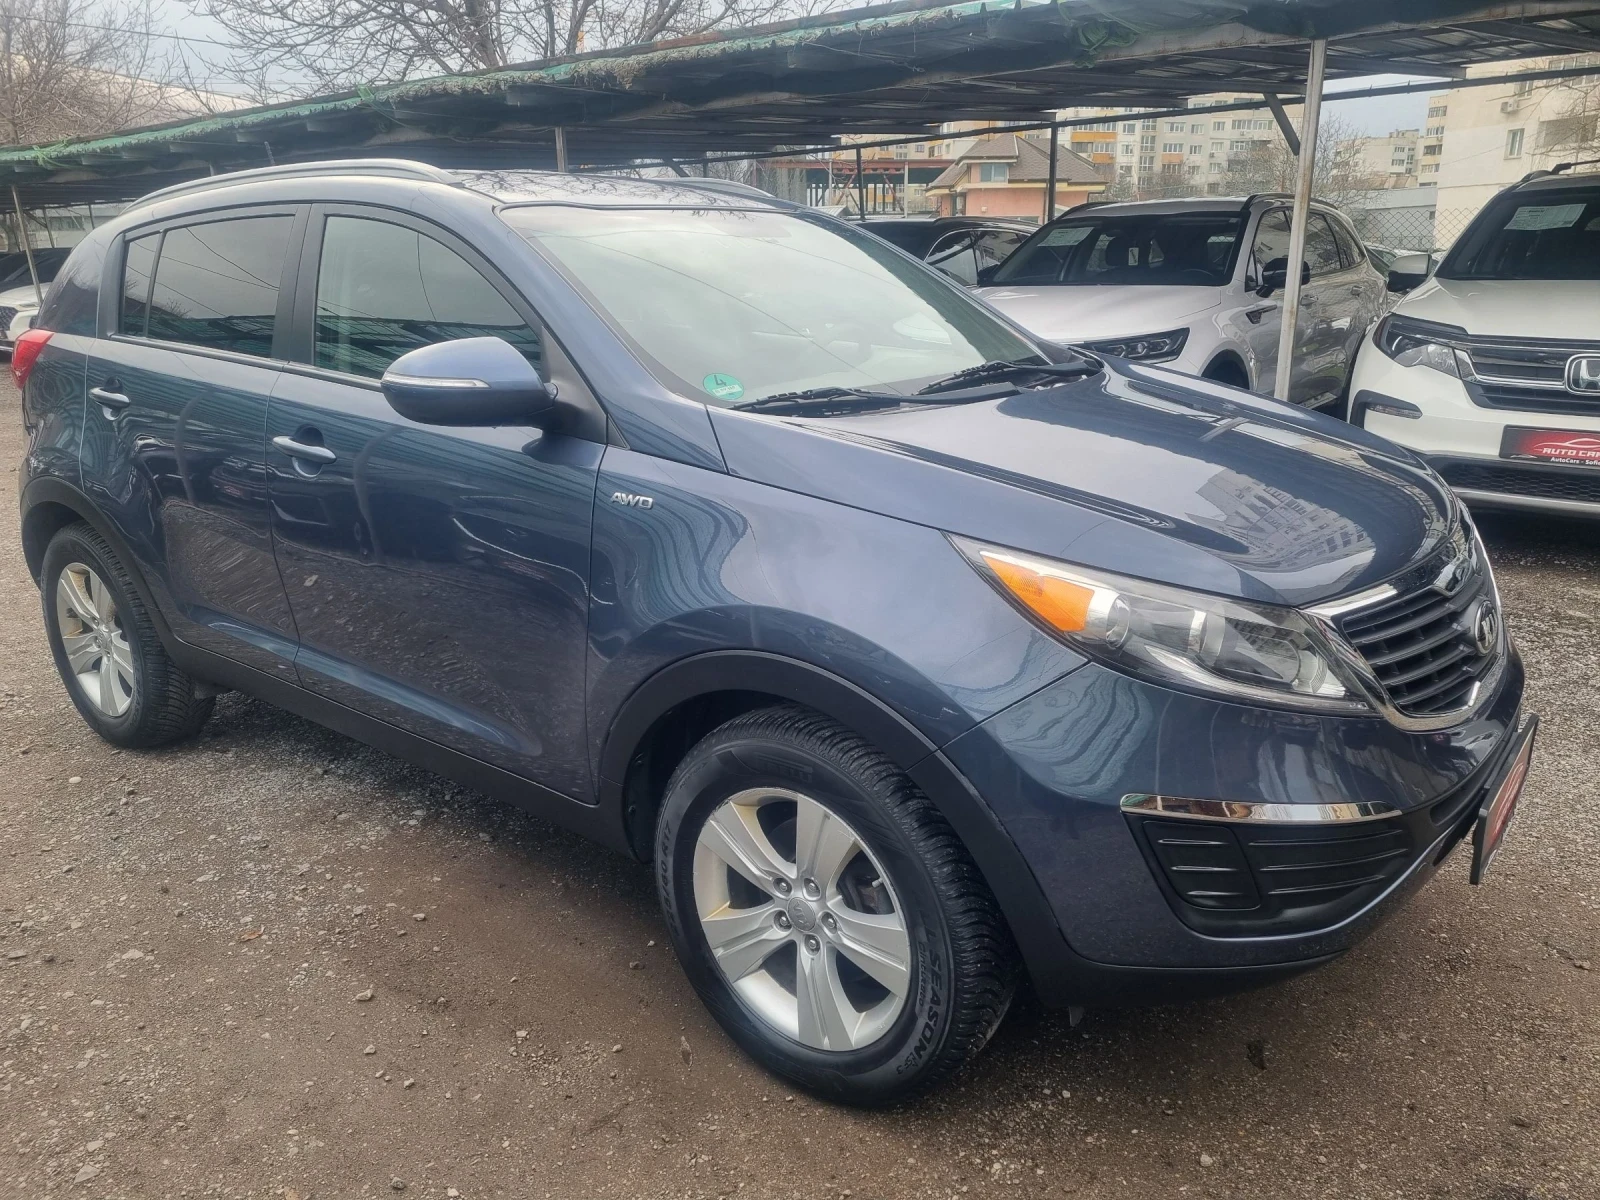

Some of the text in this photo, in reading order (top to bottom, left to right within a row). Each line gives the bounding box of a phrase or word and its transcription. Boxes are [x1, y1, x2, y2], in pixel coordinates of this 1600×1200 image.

[713, 374, 727, 386] 4
[1542, 448, 1576, 456] AUTO
[611, 492, 653, 509] AWD
[913, 951, 942, 1059] SEASON
